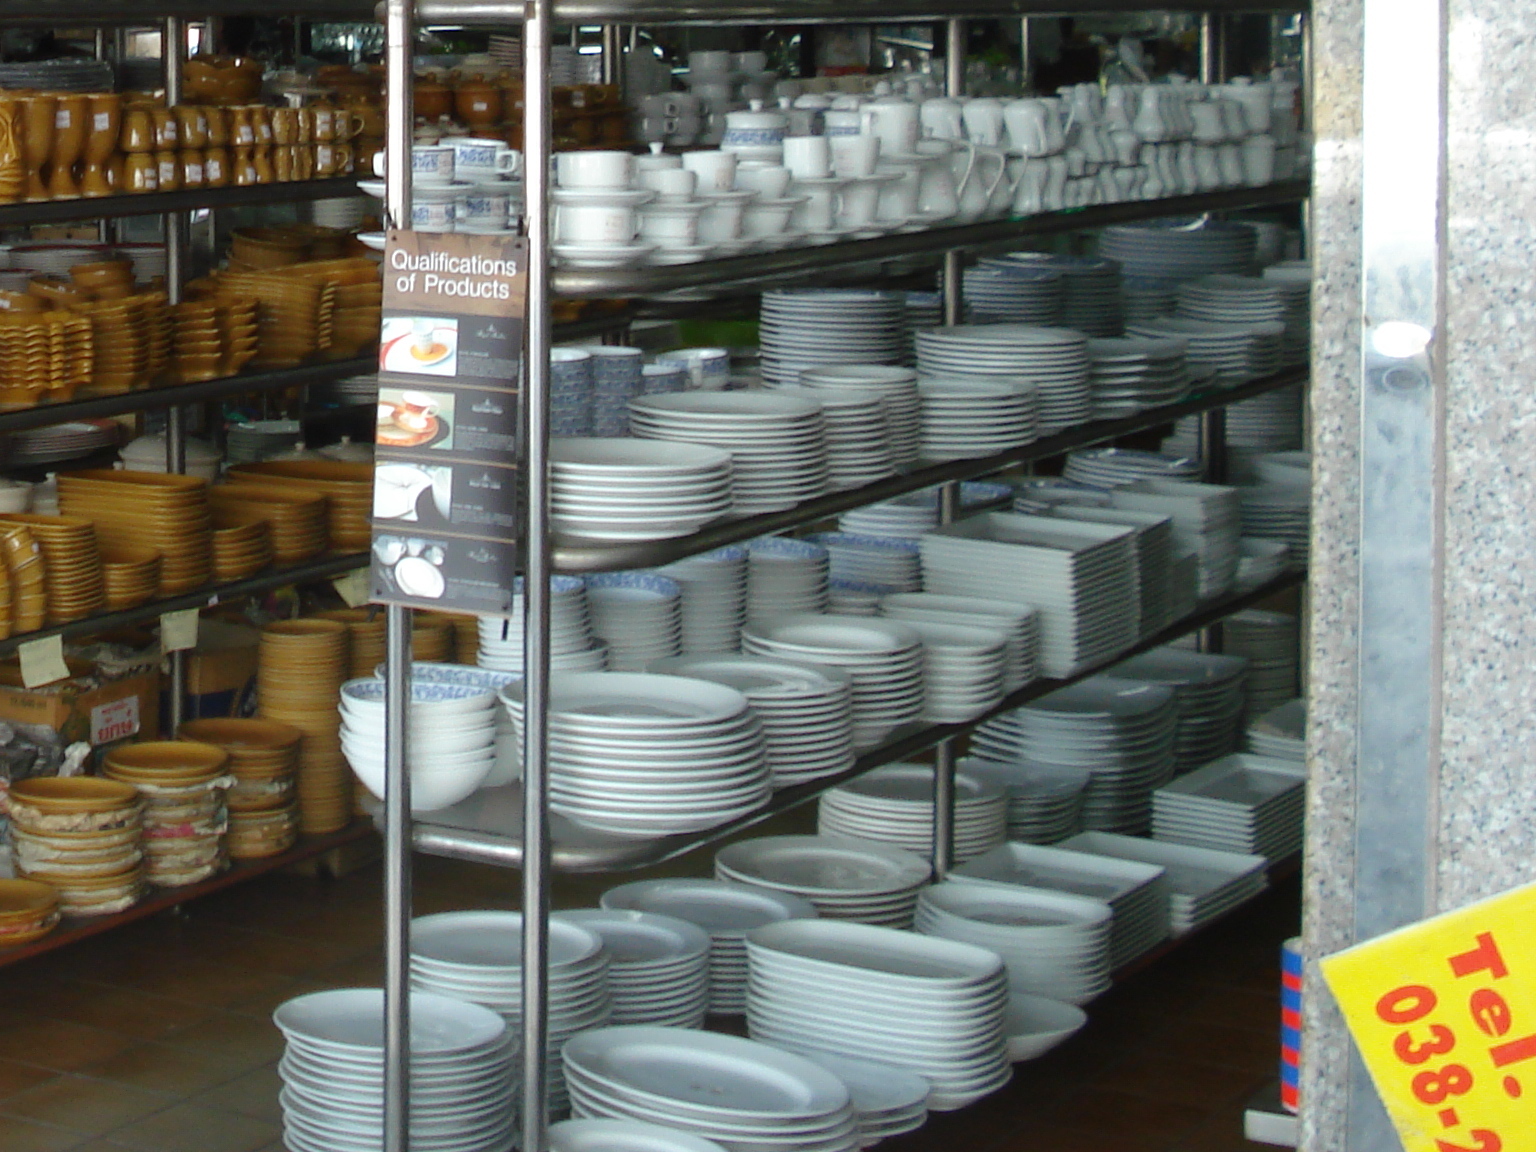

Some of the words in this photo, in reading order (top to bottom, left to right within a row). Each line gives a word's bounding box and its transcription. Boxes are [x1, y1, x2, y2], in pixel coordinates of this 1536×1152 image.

[391, 248, 517, 277] Qualifications
[396, 273, 417, 293] of
[424, 273, 510, 300] Products
